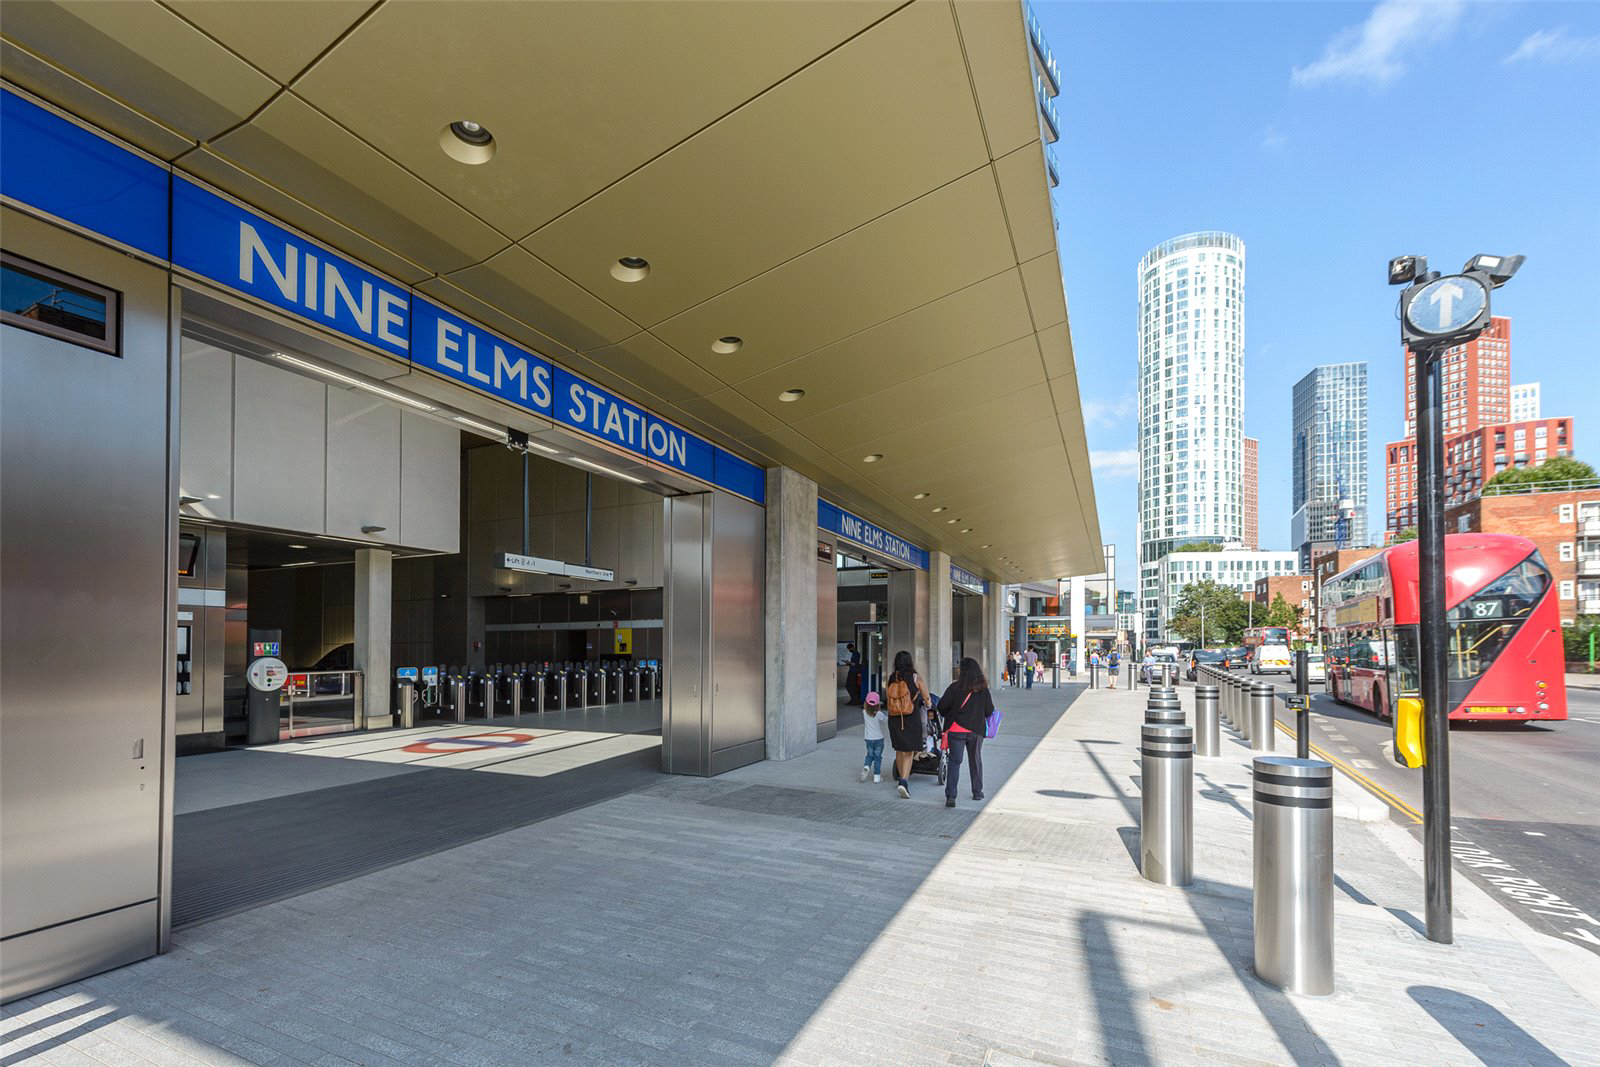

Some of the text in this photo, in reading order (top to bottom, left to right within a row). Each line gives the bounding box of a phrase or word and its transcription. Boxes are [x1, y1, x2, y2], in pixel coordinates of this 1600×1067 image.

[239, 220, 686, 466] NINE ELMS STATION
[841, 513, 910, 561] NINE ELMS STATION
[1010, 625, 1070, 638] nsbury's
[1475, 602, 1498, 616] 87
[1480, 873, 1600, 926] RIGHT
